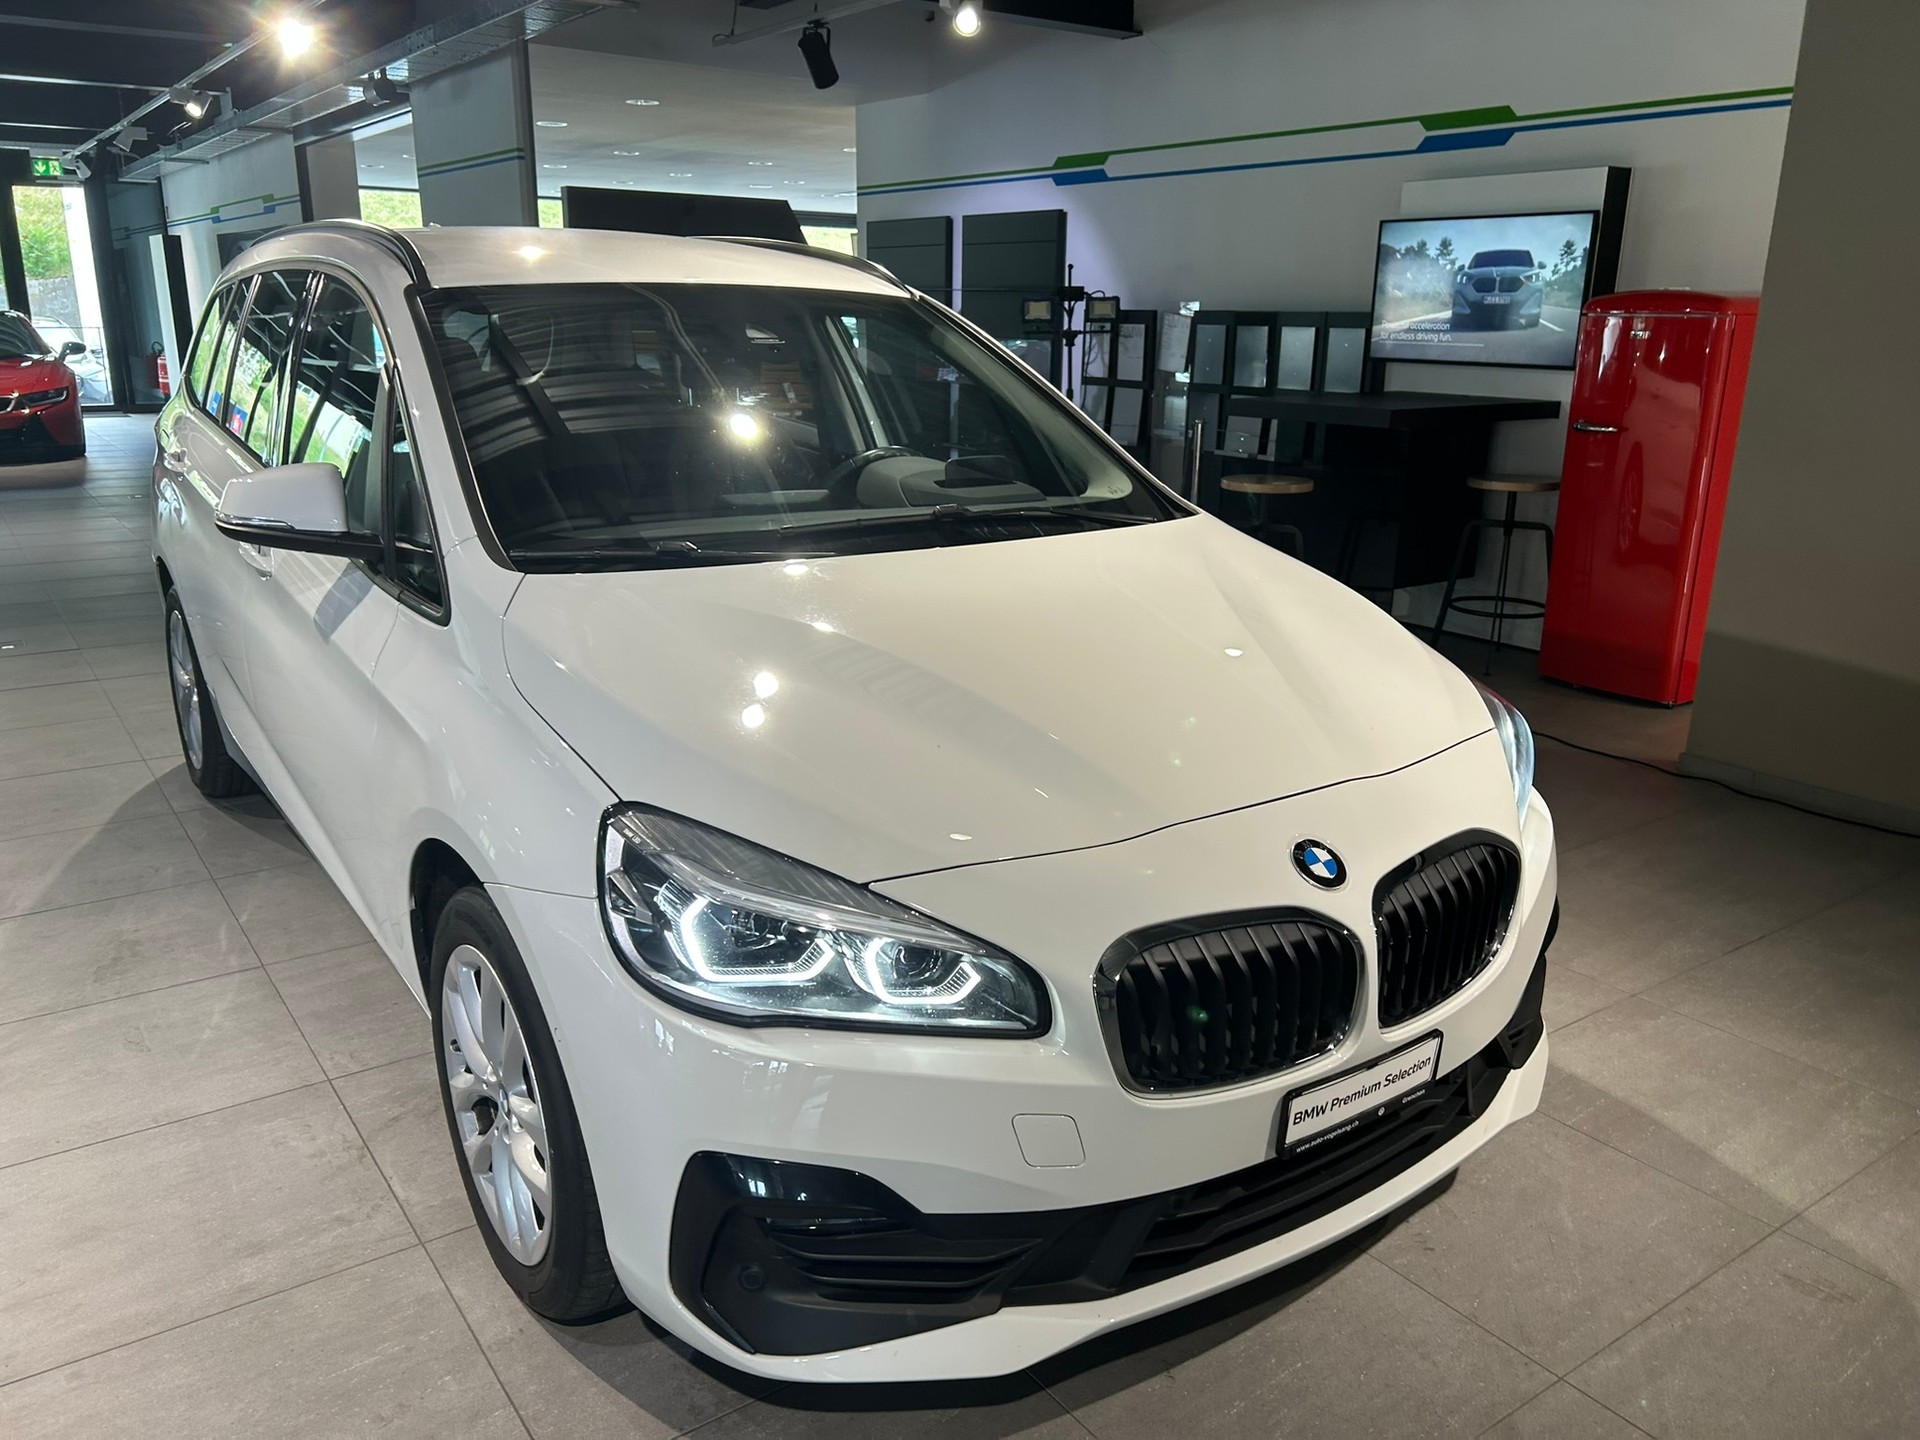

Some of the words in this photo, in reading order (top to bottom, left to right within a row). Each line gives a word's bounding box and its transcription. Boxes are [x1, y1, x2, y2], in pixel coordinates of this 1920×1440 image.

[1410, 322, 1450, 331] acceleration
[1390, 332, 1414, 340] endless
[1416, 333, 1438, 342] driving
[1293, 1102, 1328, 1125] BMW
[1330, 1081, 1381, 1112] Premium
[1383, 1056, 1431, 1088] Selection
